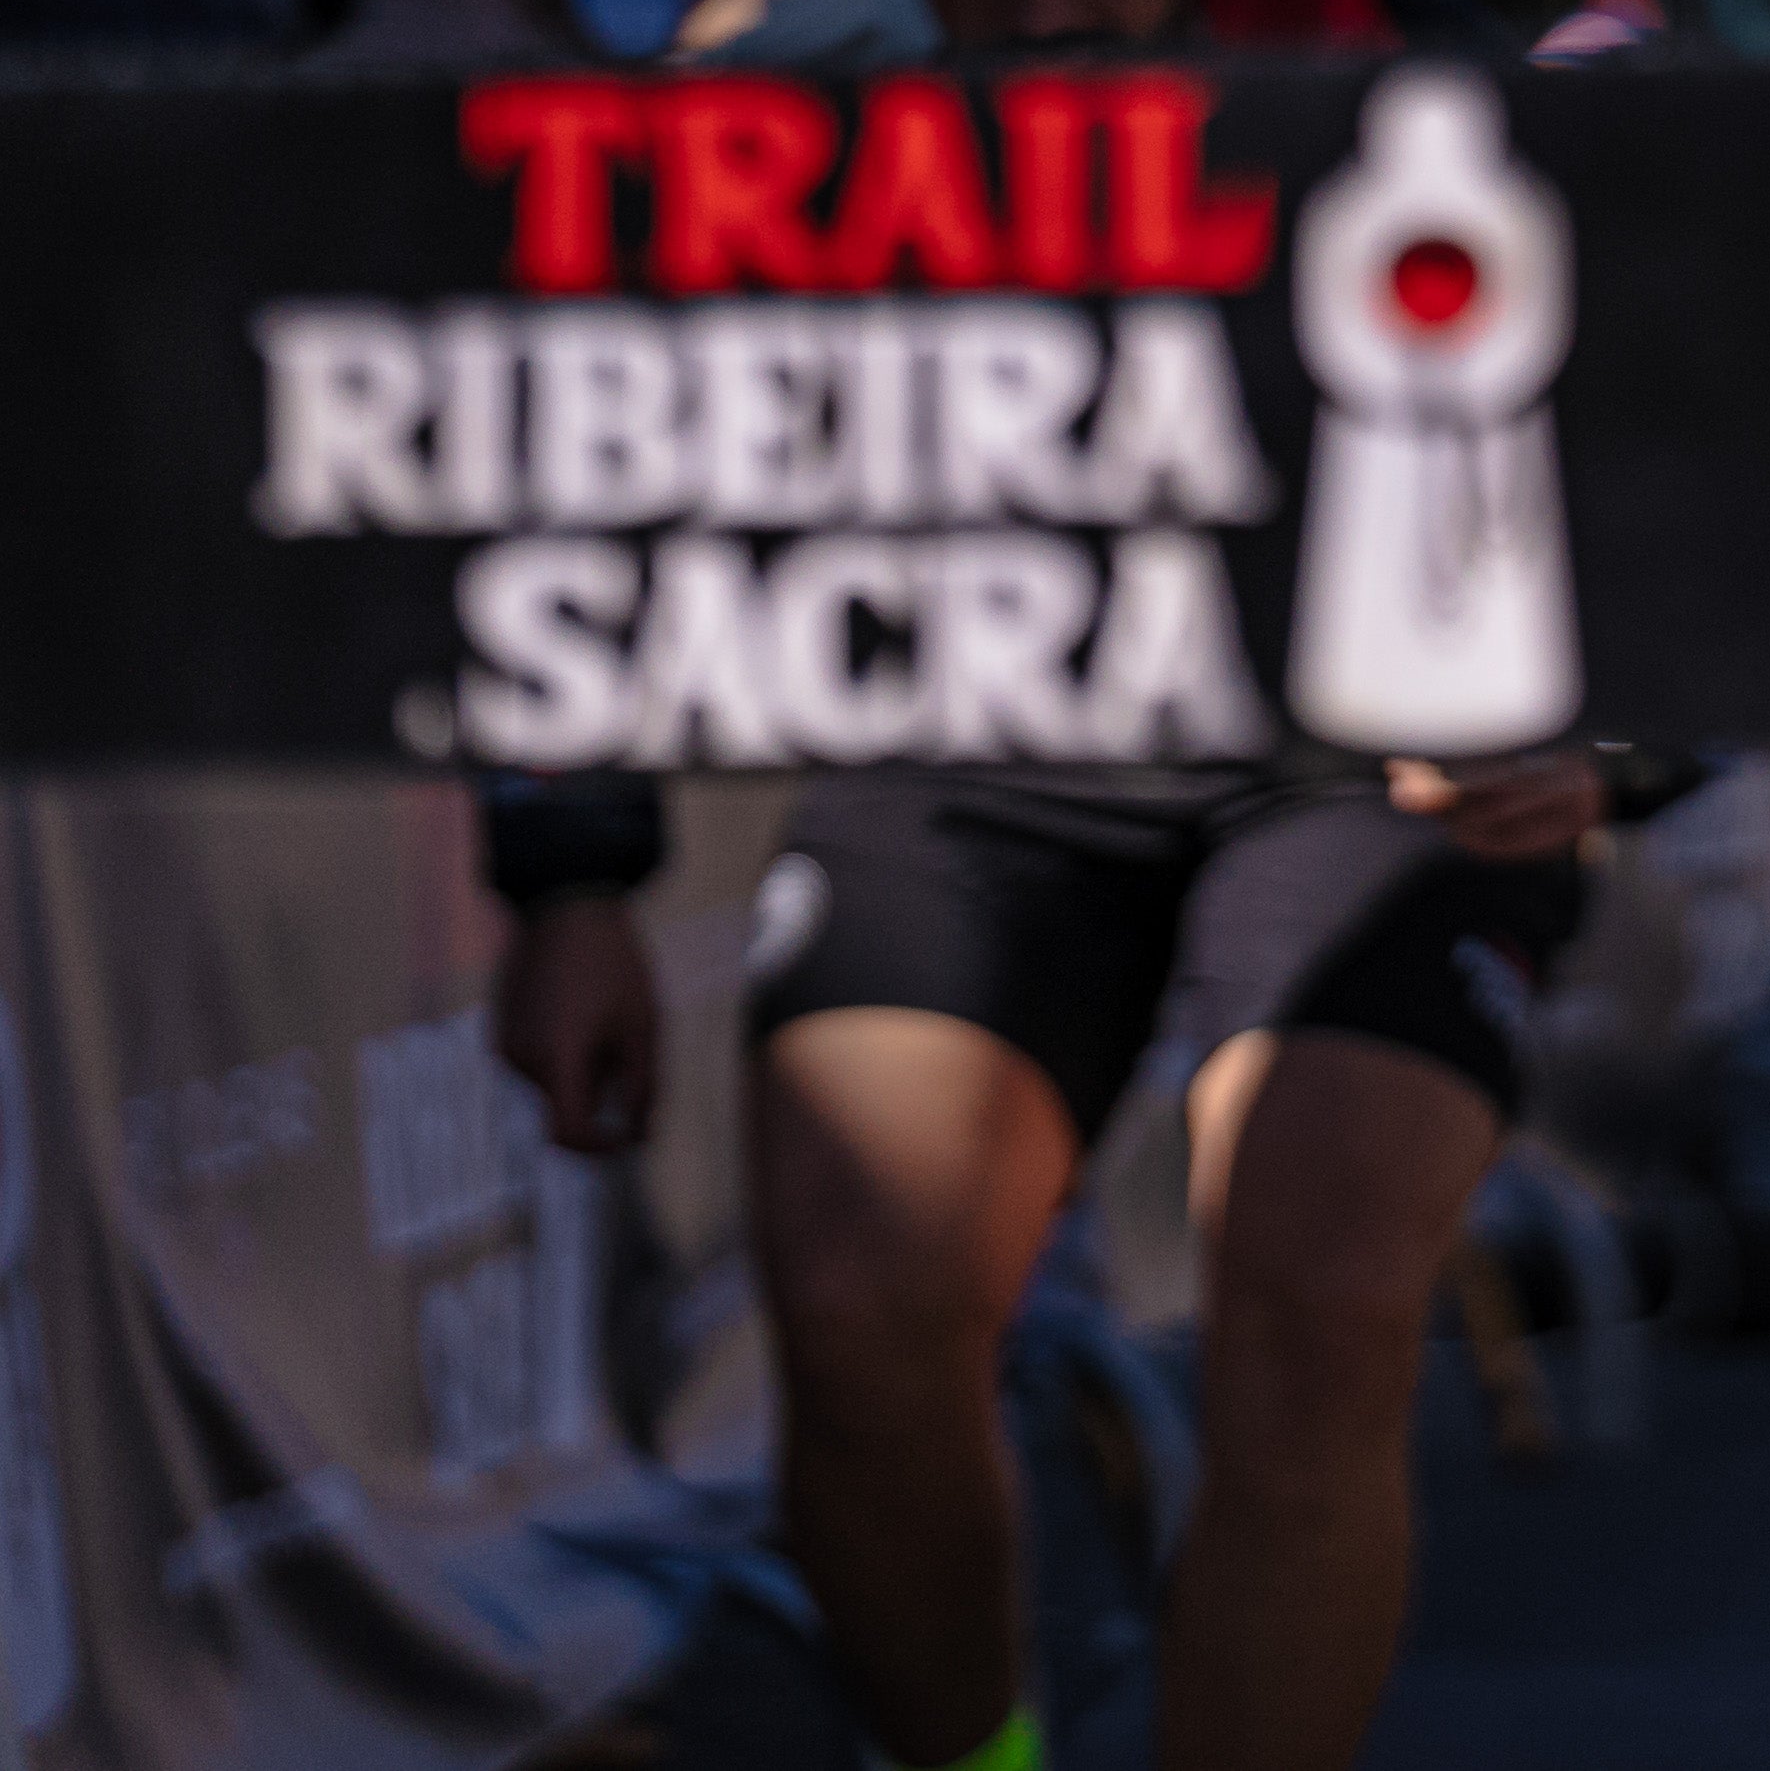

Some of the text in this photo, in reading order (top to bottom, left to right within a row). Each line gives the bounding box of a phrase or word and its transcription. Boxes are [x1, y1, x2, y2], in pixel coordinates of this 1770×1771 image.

[460, 71, 1278, 294] TRAIL
[249, 297, 1278, 537] RIBEIRA
[452, 531, 1278, 771] SACRA
